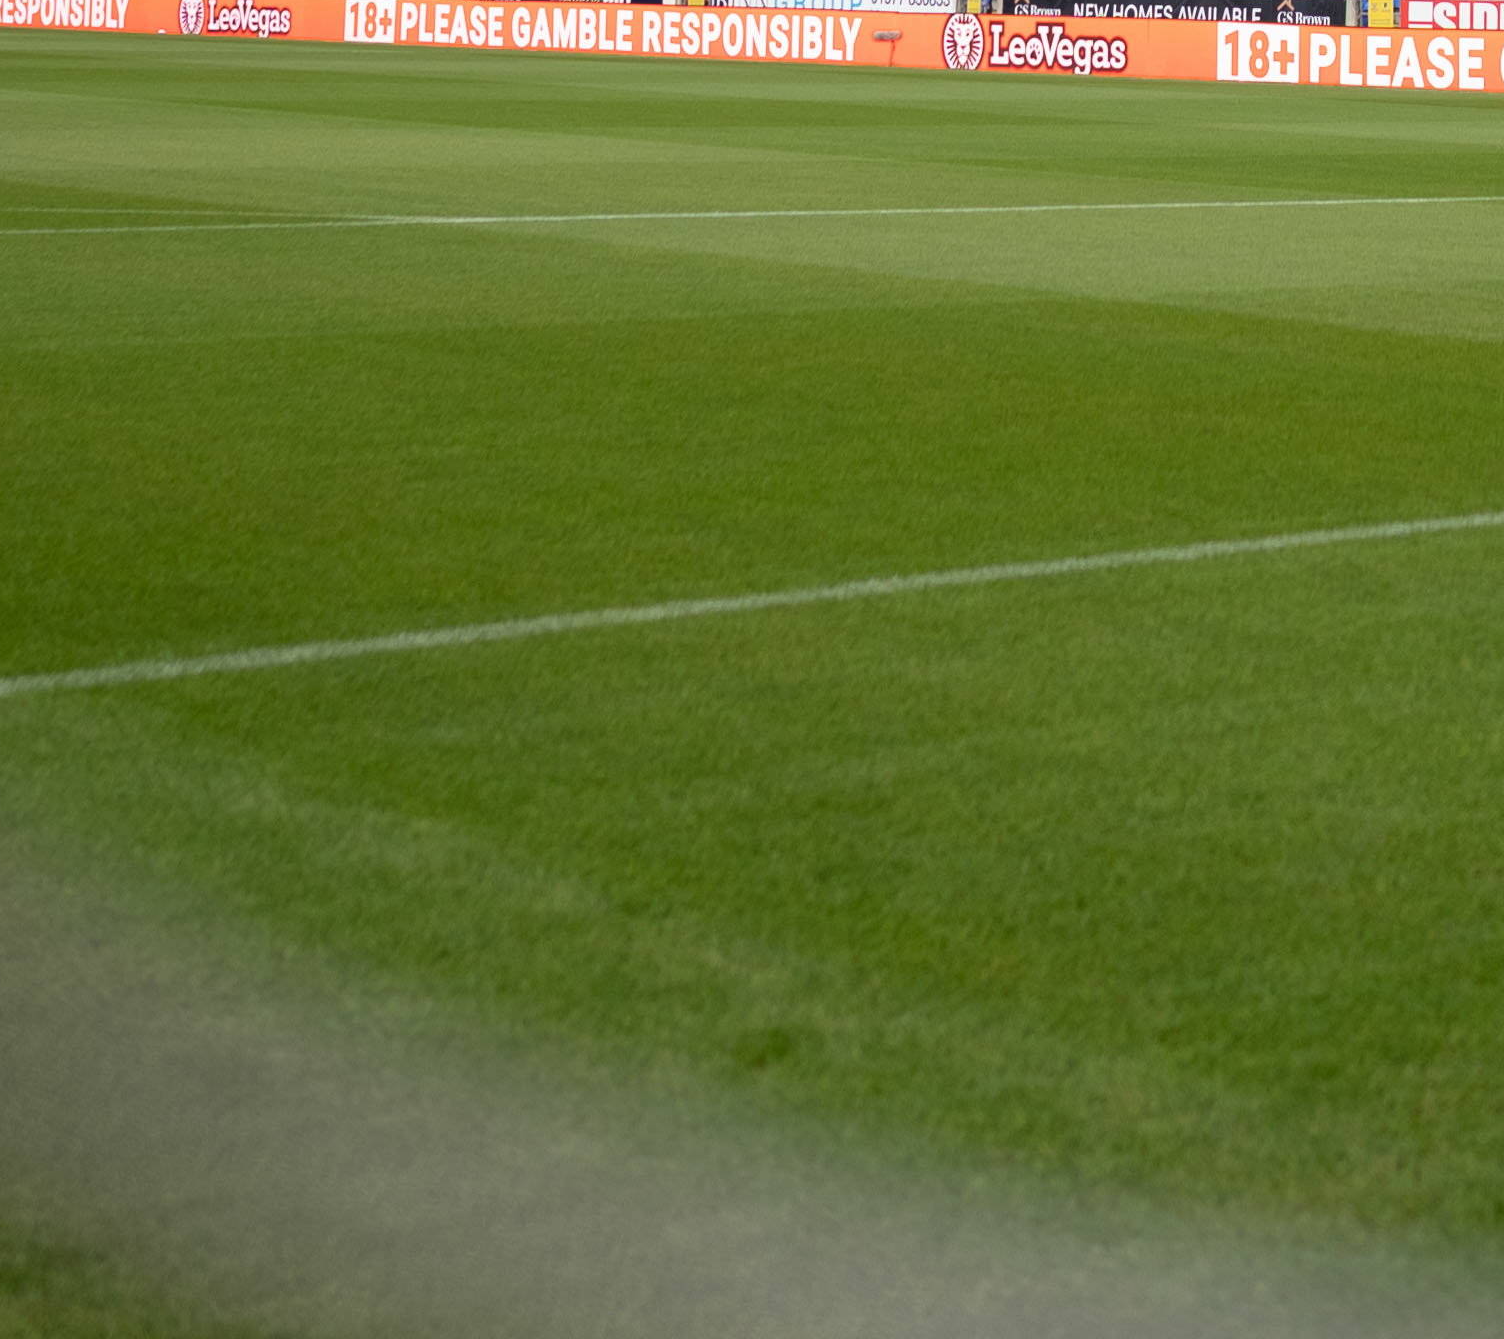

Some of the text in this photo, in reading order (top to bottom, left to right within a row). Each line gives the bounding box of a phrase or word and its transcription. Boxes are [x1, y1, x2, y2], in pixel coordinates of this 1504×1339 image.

[207, 0, 291, 38] LeoVegas
[347, 1, 862, 61] 18+ PLEASE GAMBLE RESPONSIBLY
[989, 23, 1128, 75] LeoVegas
[1223, 26, 1295, 78] 18+
[1310, 32, 1485, 91] PLEASE
